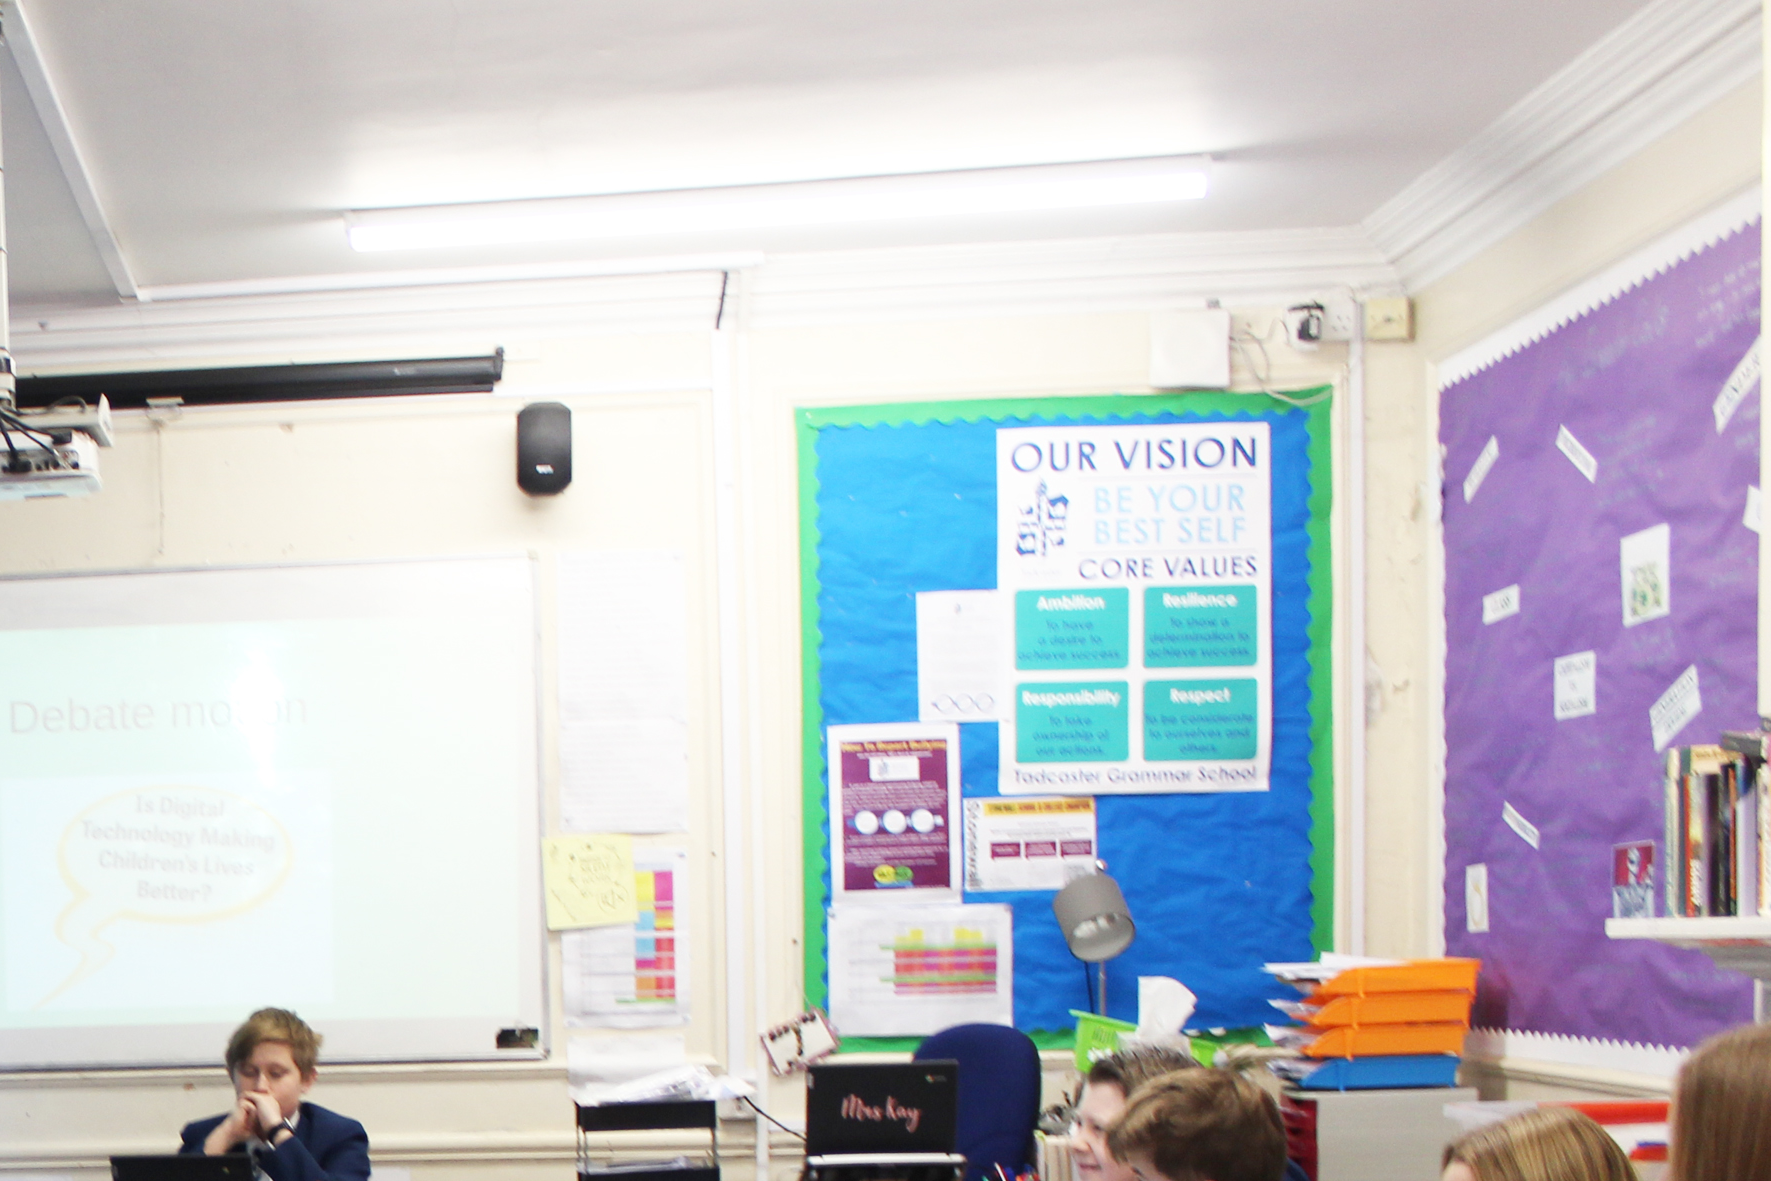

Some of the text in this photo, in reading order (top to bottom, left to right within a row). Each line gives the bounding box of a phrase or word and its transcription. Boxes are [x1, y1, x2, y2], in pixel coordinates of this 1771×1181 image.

[1011, 436, 1256, 473] OUR VISION
[1094, 483, 1245, 513] BE YOUR
[1094, 516, 1245, 544] BEST SELF
[1079, 556, 1257, 579] CORE VALUES
[1036, 594, 1106, 611] Ambition
[1162, 591, 1238, 608] Resilience
[1022, 689, 1121, 708] Responsibility
[1170, 686, 1231, 707] Respect
[8, 697, 156, 735] Debate
[1013, 765, 1256, 784] Tadcaster Grammar School
[134, 794, 225, 820] Is Digital
[80, 819, 275, 853] Technology Making
[97, 849, 255, 876] Children's Lives
[136, 880, 213, 902] Better?
